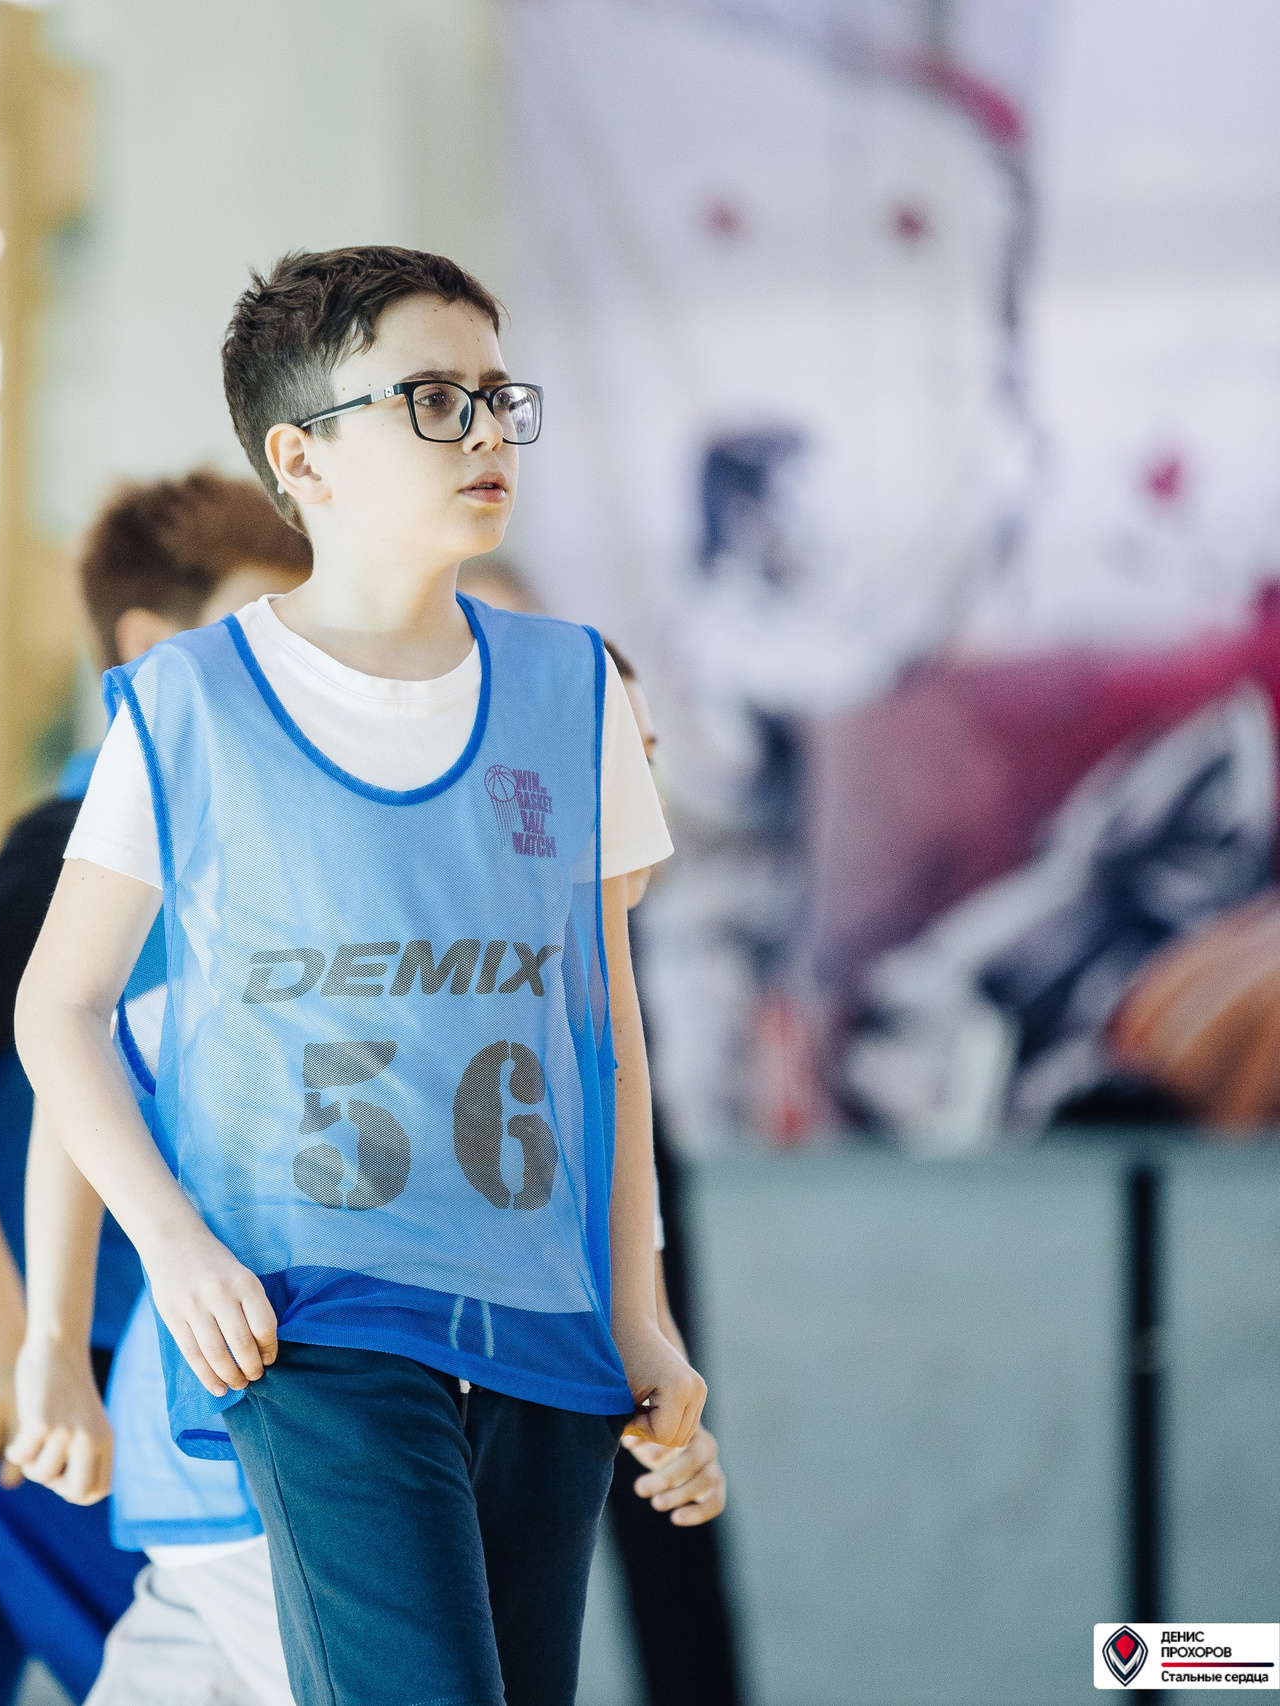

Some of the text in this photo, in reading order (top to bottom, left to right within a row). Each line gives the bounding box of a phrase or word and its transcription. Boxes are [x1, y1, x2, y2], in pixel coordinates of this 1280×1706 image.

[512, 768, 540, 793] WIN
[516, 790, 553, 814] BASKET
[520, 809, 546, 835] BALL
[512, 831, 557, 858] MATCH
[241, 938, 562, 1004] DEMIX
